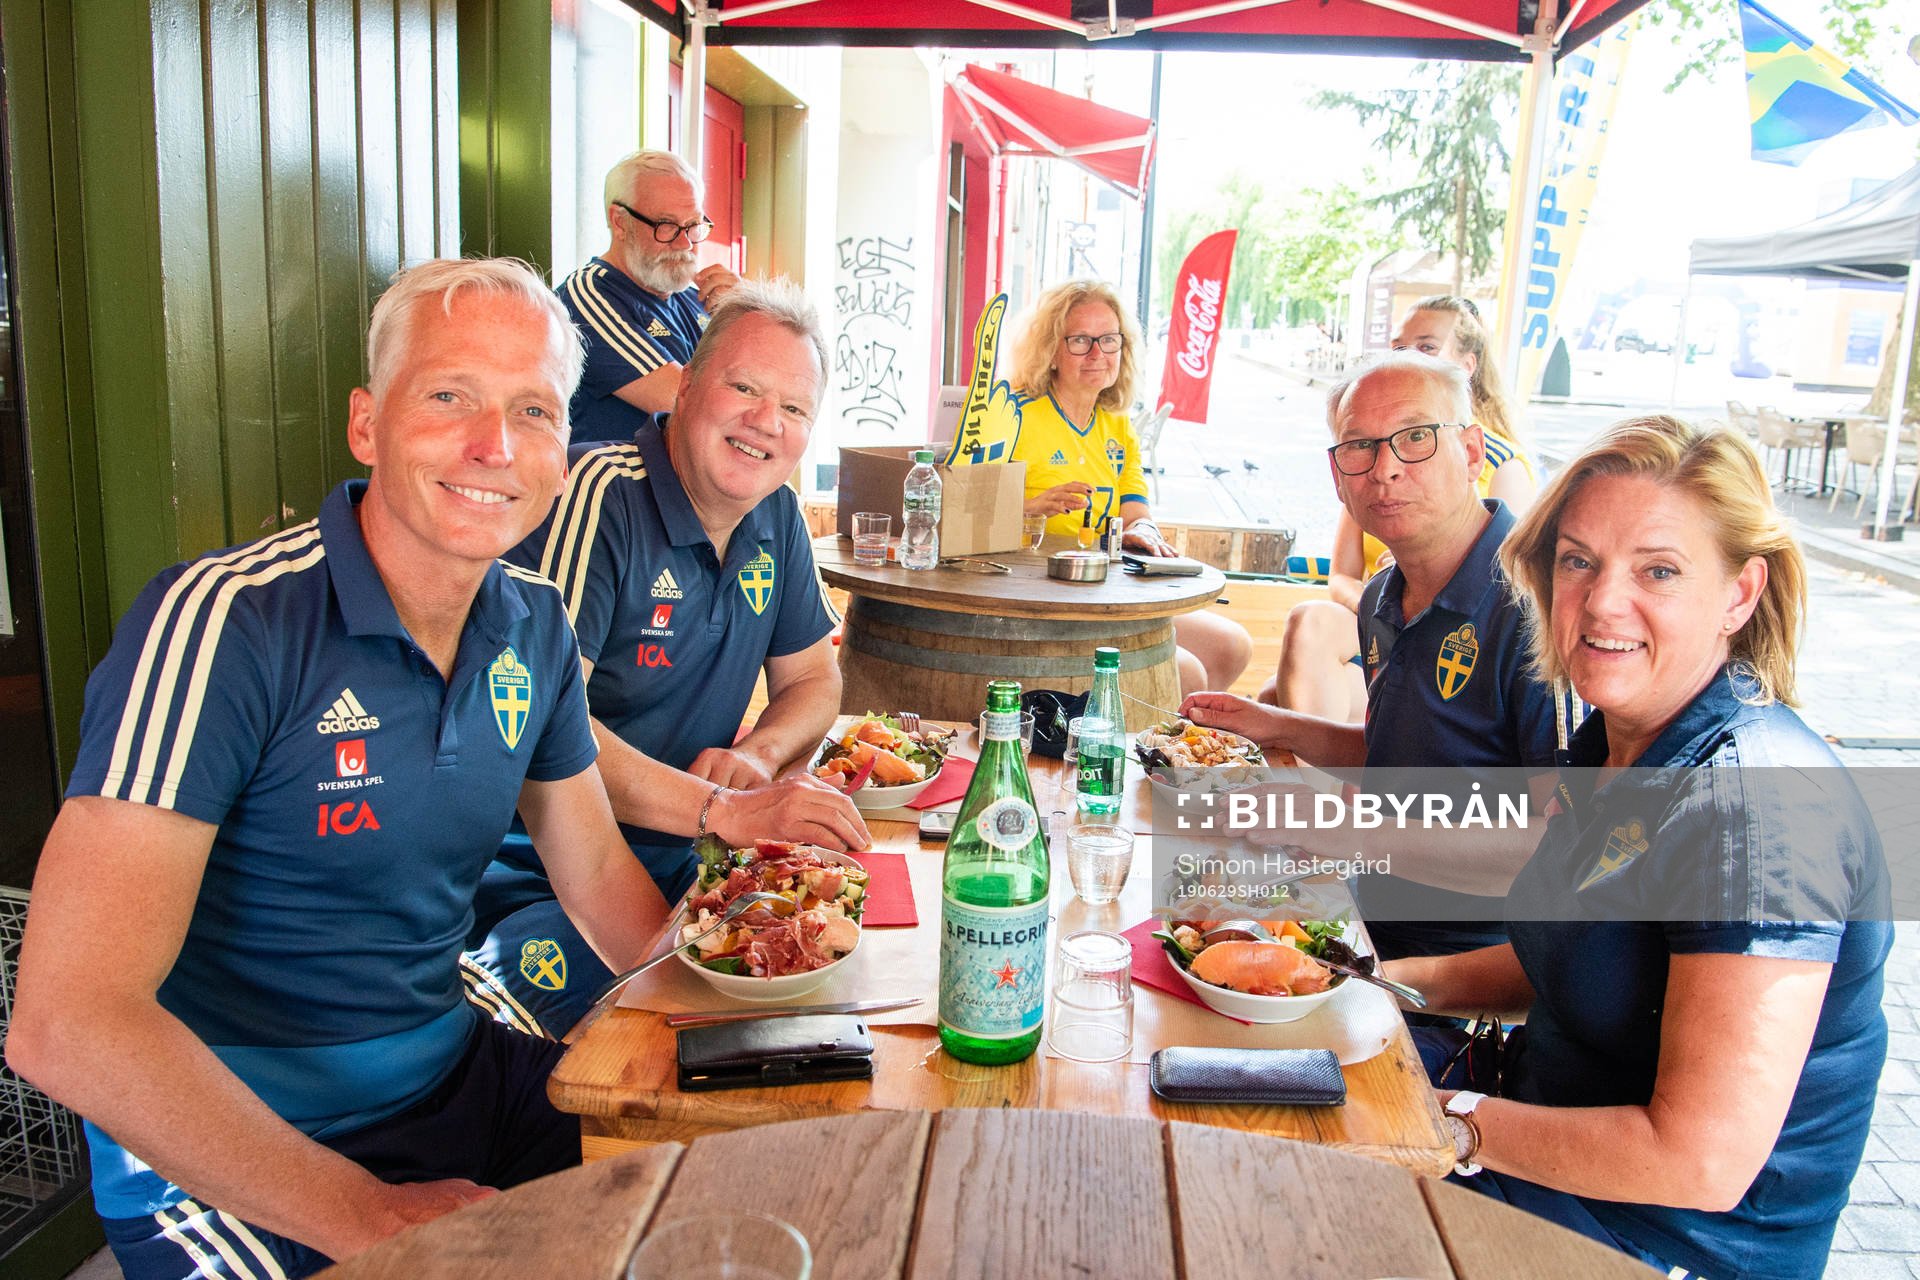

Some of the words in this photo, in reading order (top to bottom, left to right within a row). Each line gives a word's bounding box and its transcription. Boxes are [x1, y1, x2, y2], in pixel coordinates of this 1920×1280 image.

[1176, 272, 1222, 379] Coca-Cola
[650, 587, 683, 600] adidas
[636, 643, 673, 668] ICA
[1447, 641, 1474, 656] SVERIGE
[497, 675, 525, 685] SVERIGE
[316, 714, 381, 735] adidas
[317, 779, 363, 791] SVENSKA
[364, 775, 385, 787] SPEL
[316, 799, 382, 837] ICA
